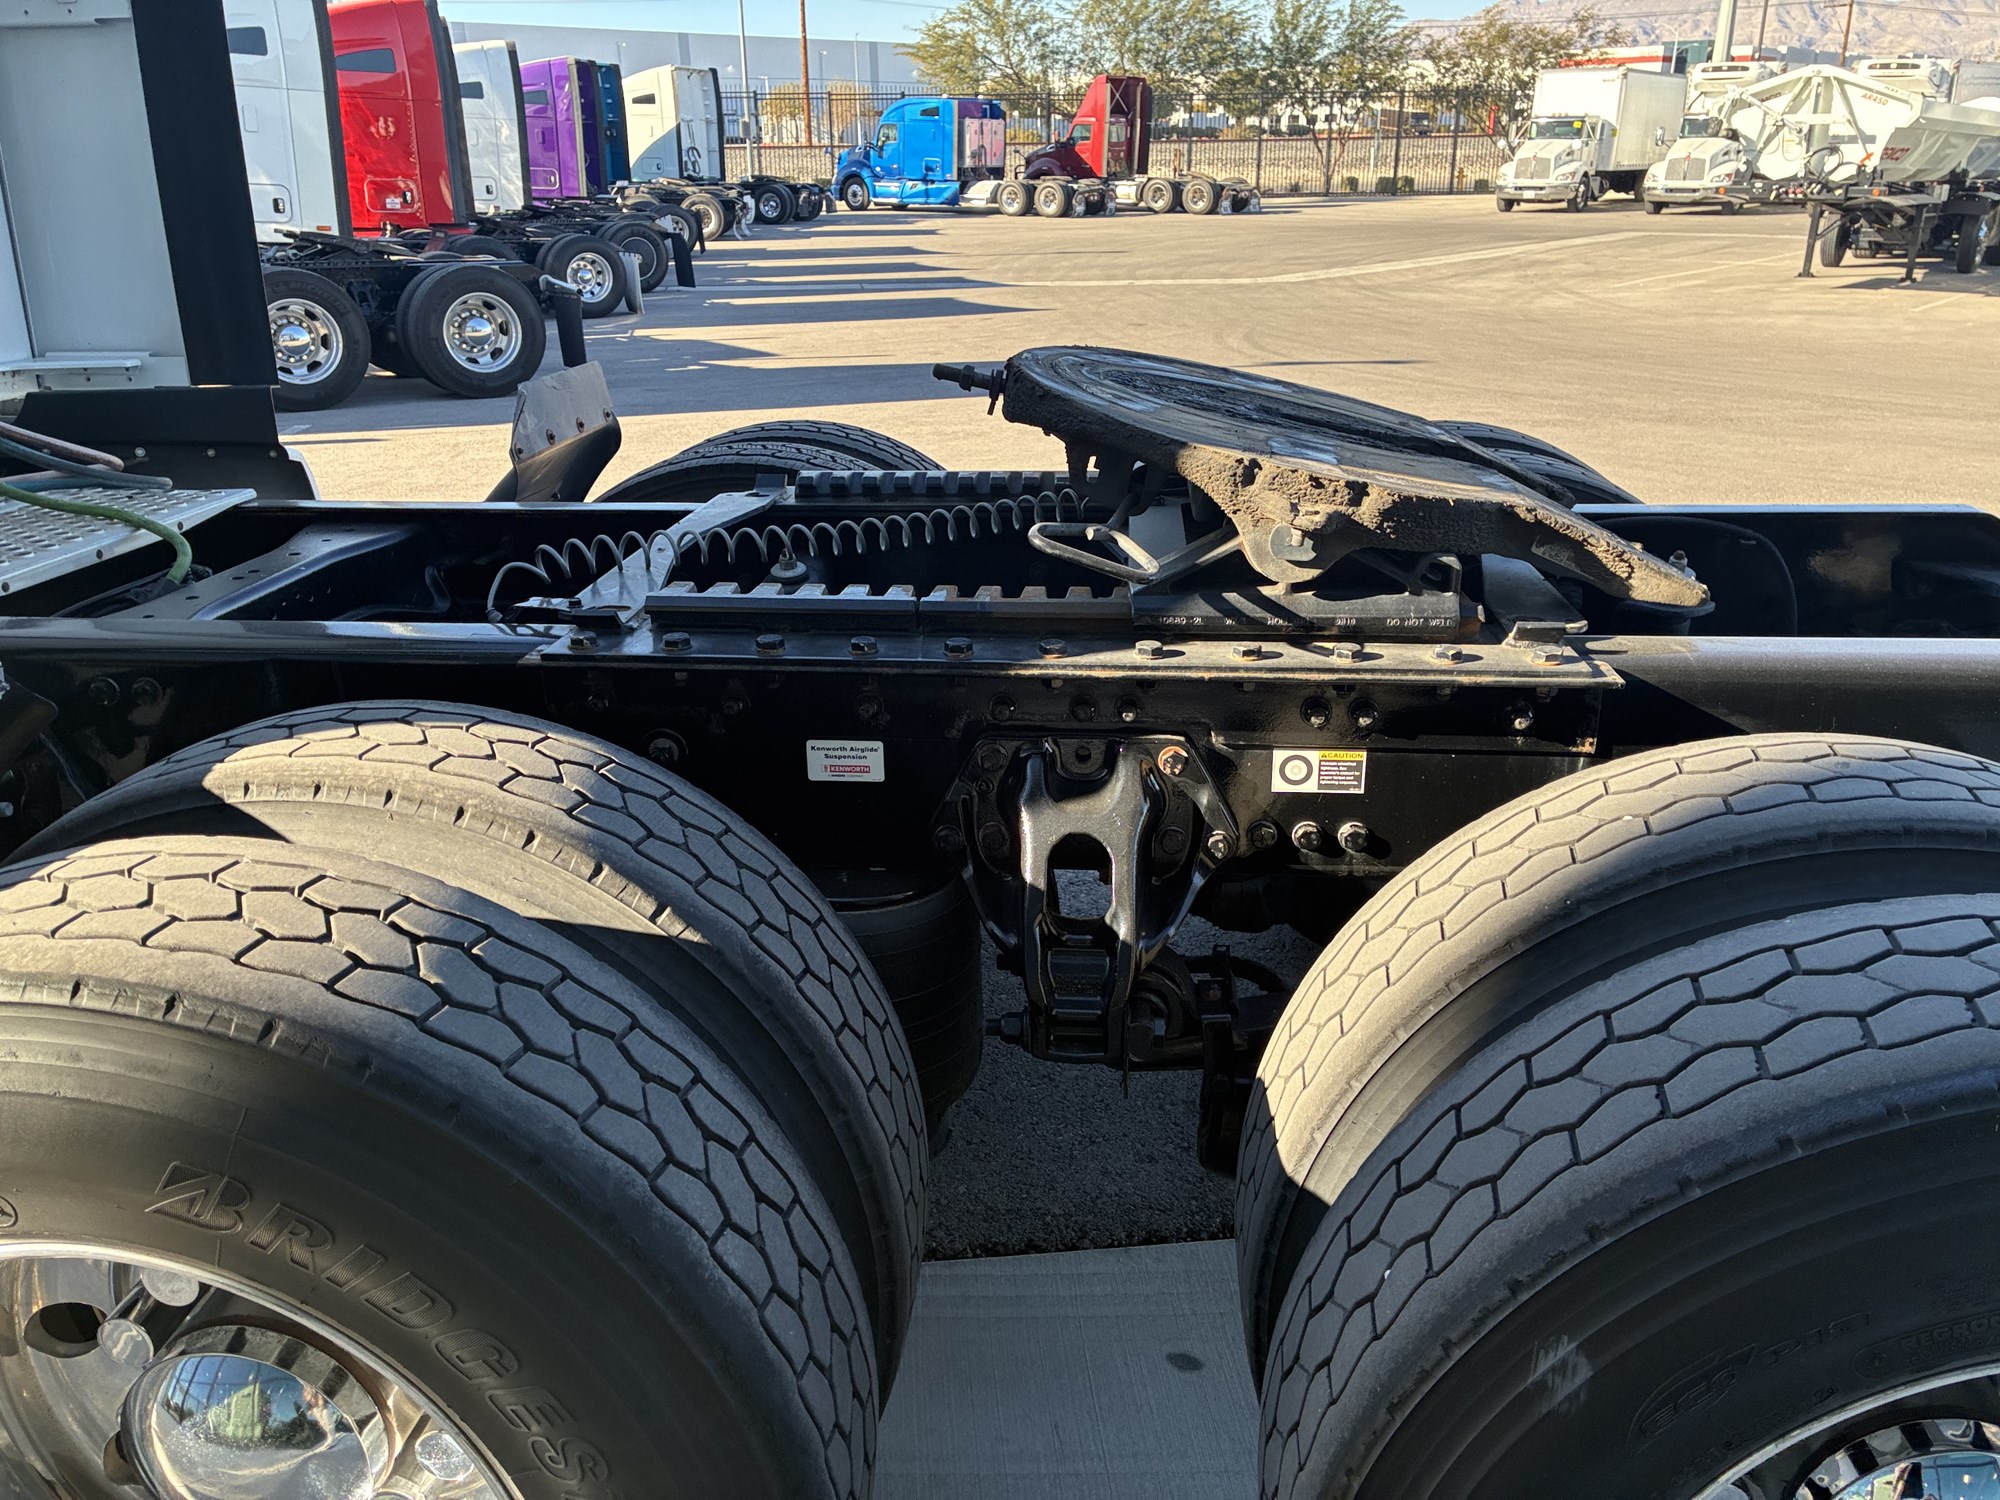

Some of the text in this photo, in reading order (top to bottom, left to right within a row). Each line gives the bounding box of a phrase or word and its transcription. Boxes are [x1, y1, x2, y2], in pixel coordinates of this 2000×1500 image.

[1861, 92, 1889, 106] AR450
[1404, 617, 1424, 626] NOT
[811, 745, 847, 753] Kenworth
[830, 765, 870, 773] KENWORTH
[144, 1161, 611, 1500] BRIDGES
